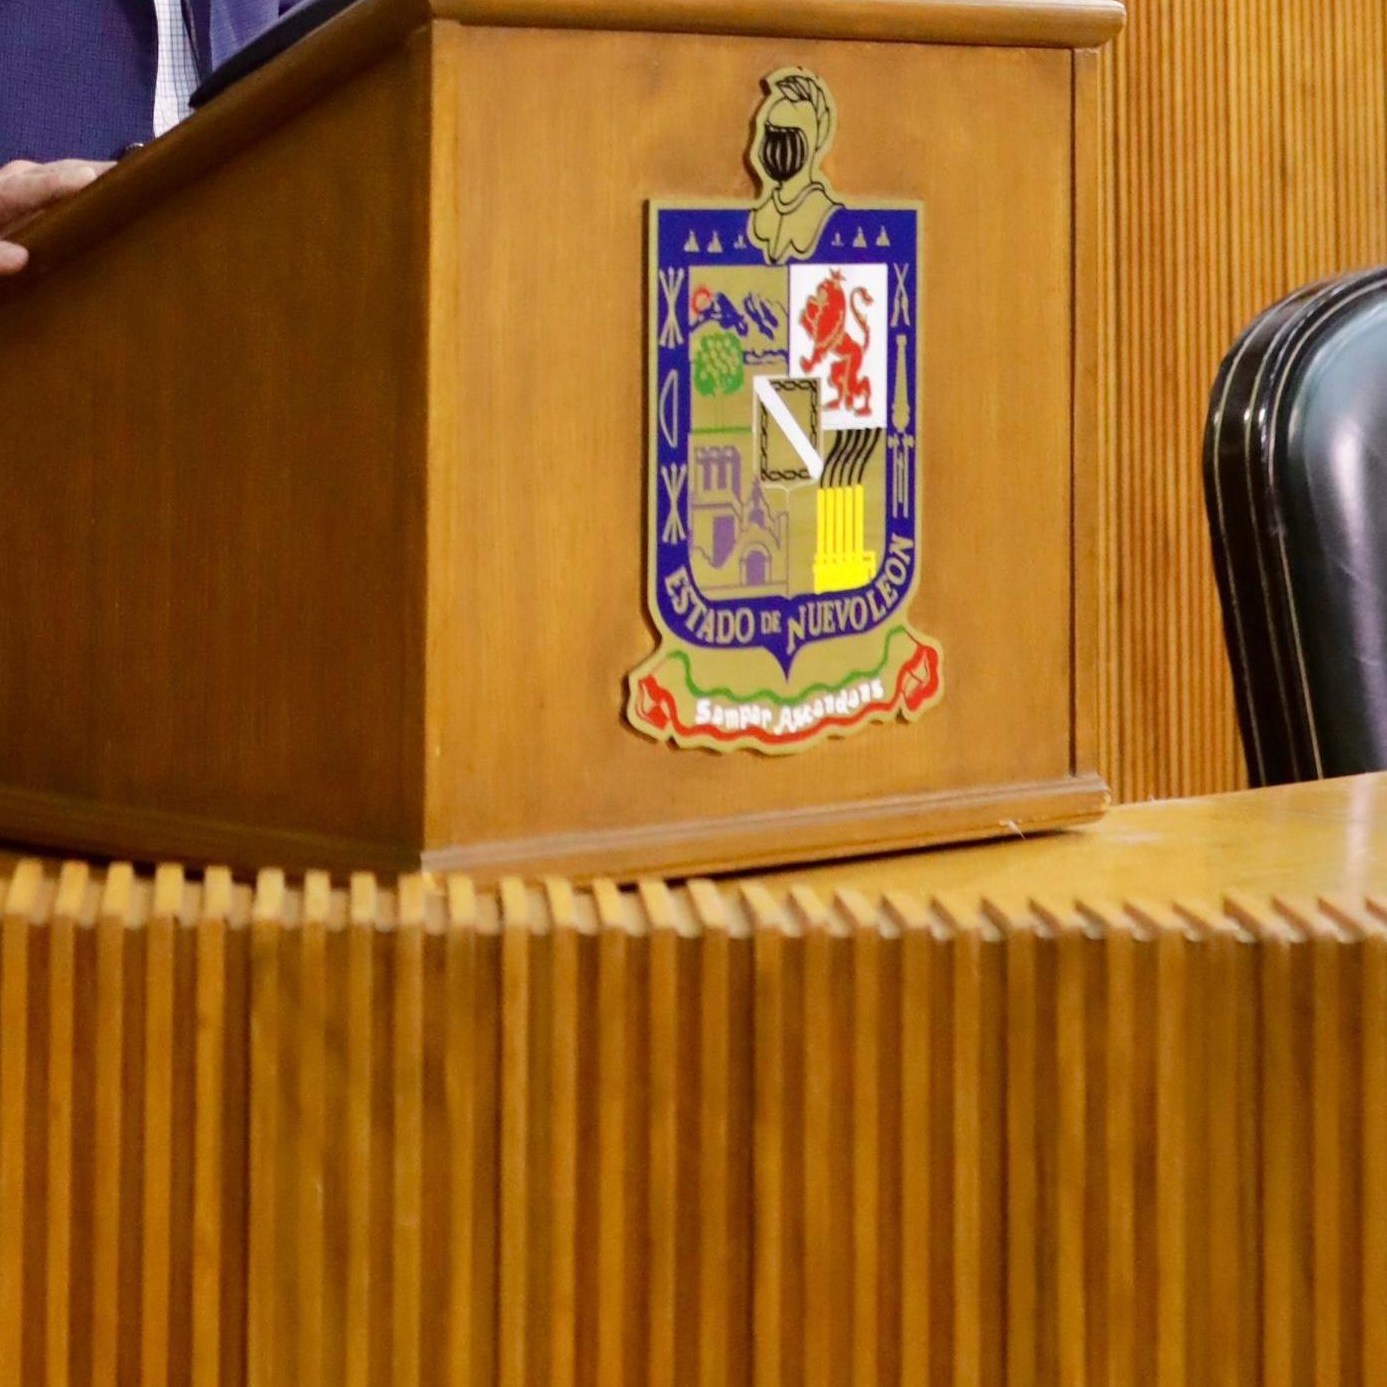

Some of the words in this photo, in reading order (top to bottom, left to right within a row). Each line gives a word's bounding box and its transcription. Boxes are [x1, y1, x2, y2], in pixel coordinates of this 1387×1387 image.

[665, 566, 754, 643] ESTADO
[760, 611, 782, 634] DE
[787, 599, 867, 654] NUEVO
[869, 533, 913, 622] LEON
[695, 698, 773, 730] Semper
